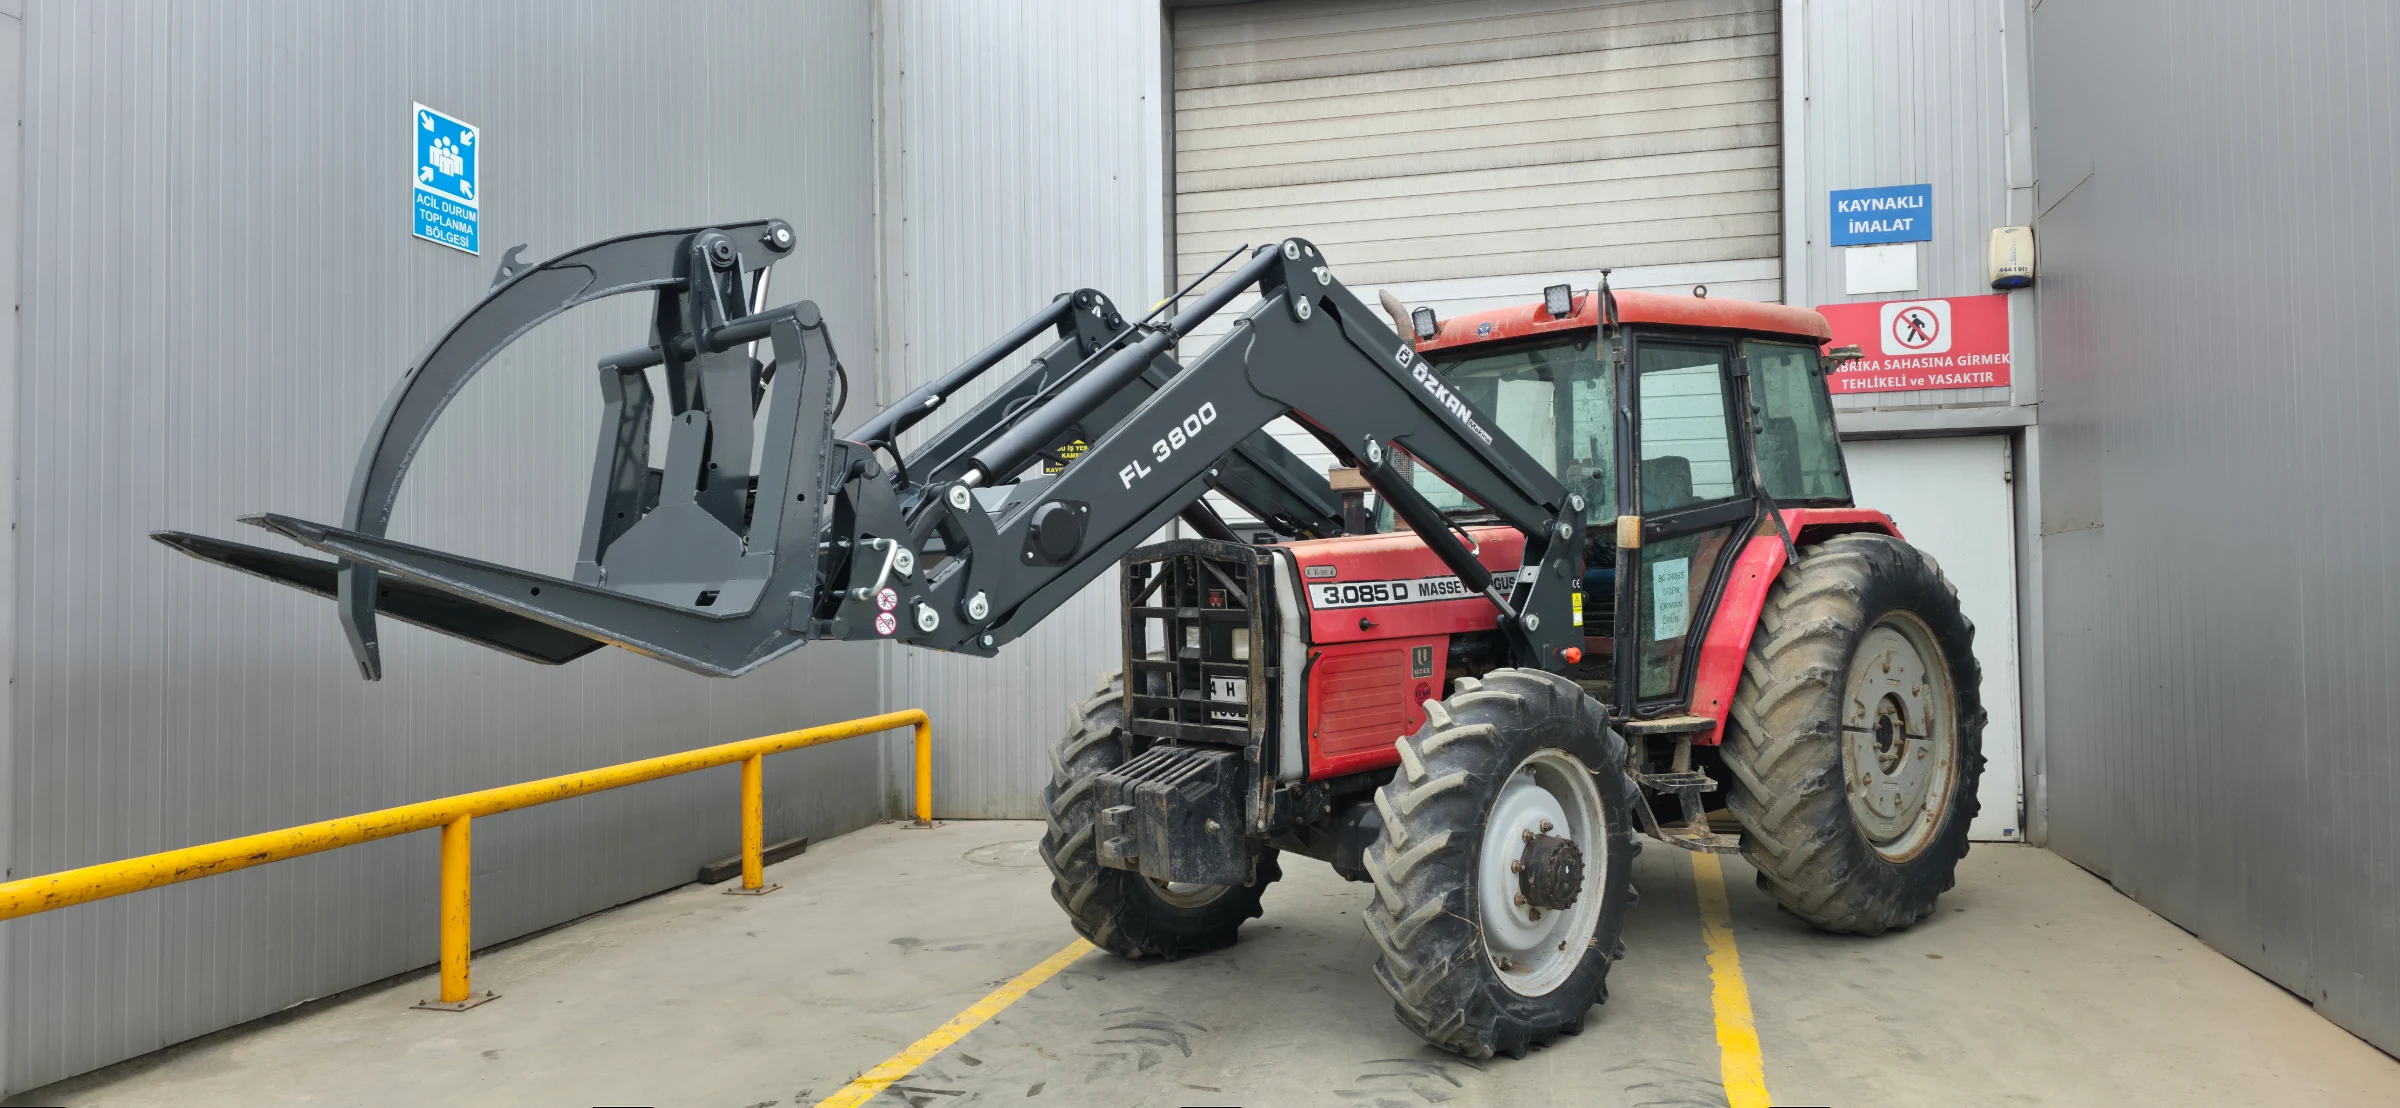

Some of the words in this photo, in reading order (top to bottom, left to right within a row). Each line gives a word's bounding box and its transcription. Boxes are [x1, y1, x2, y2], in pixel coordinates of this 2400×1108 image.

[416, 193, 440, 210] ACİL
[442, 201, 477, 223] DURUM
[1838, 195, 1923, 213] KAYNAKLI
[419, 208, 474, 236] TOPLANMA
[1849, 218, 1914, 234] İMALAT
[425, 225, 469, 248] BÖLGESİ
[1884, 356, 1954, 370] SAHASINA
[1957, 352, 2010, 367] GİRMEK
[1841, 373, 1907, 390] TEHLİKELİ
[1909, 377, 1925, 386] ve
[1928, 371, 1994, 385] YASAKTIR
[1412, 361, 1473, 425] ÖZKAN
[1118, 459, 1152, 490] FL
[1152, 401, 1217, 463] 3800
[1323, 584, 1389, 605] 3.085
[1391, 583, 1409, 600] D
[1419, 579, 1469, 597] MASSEY
[1226, 681, 1236, 697] H
